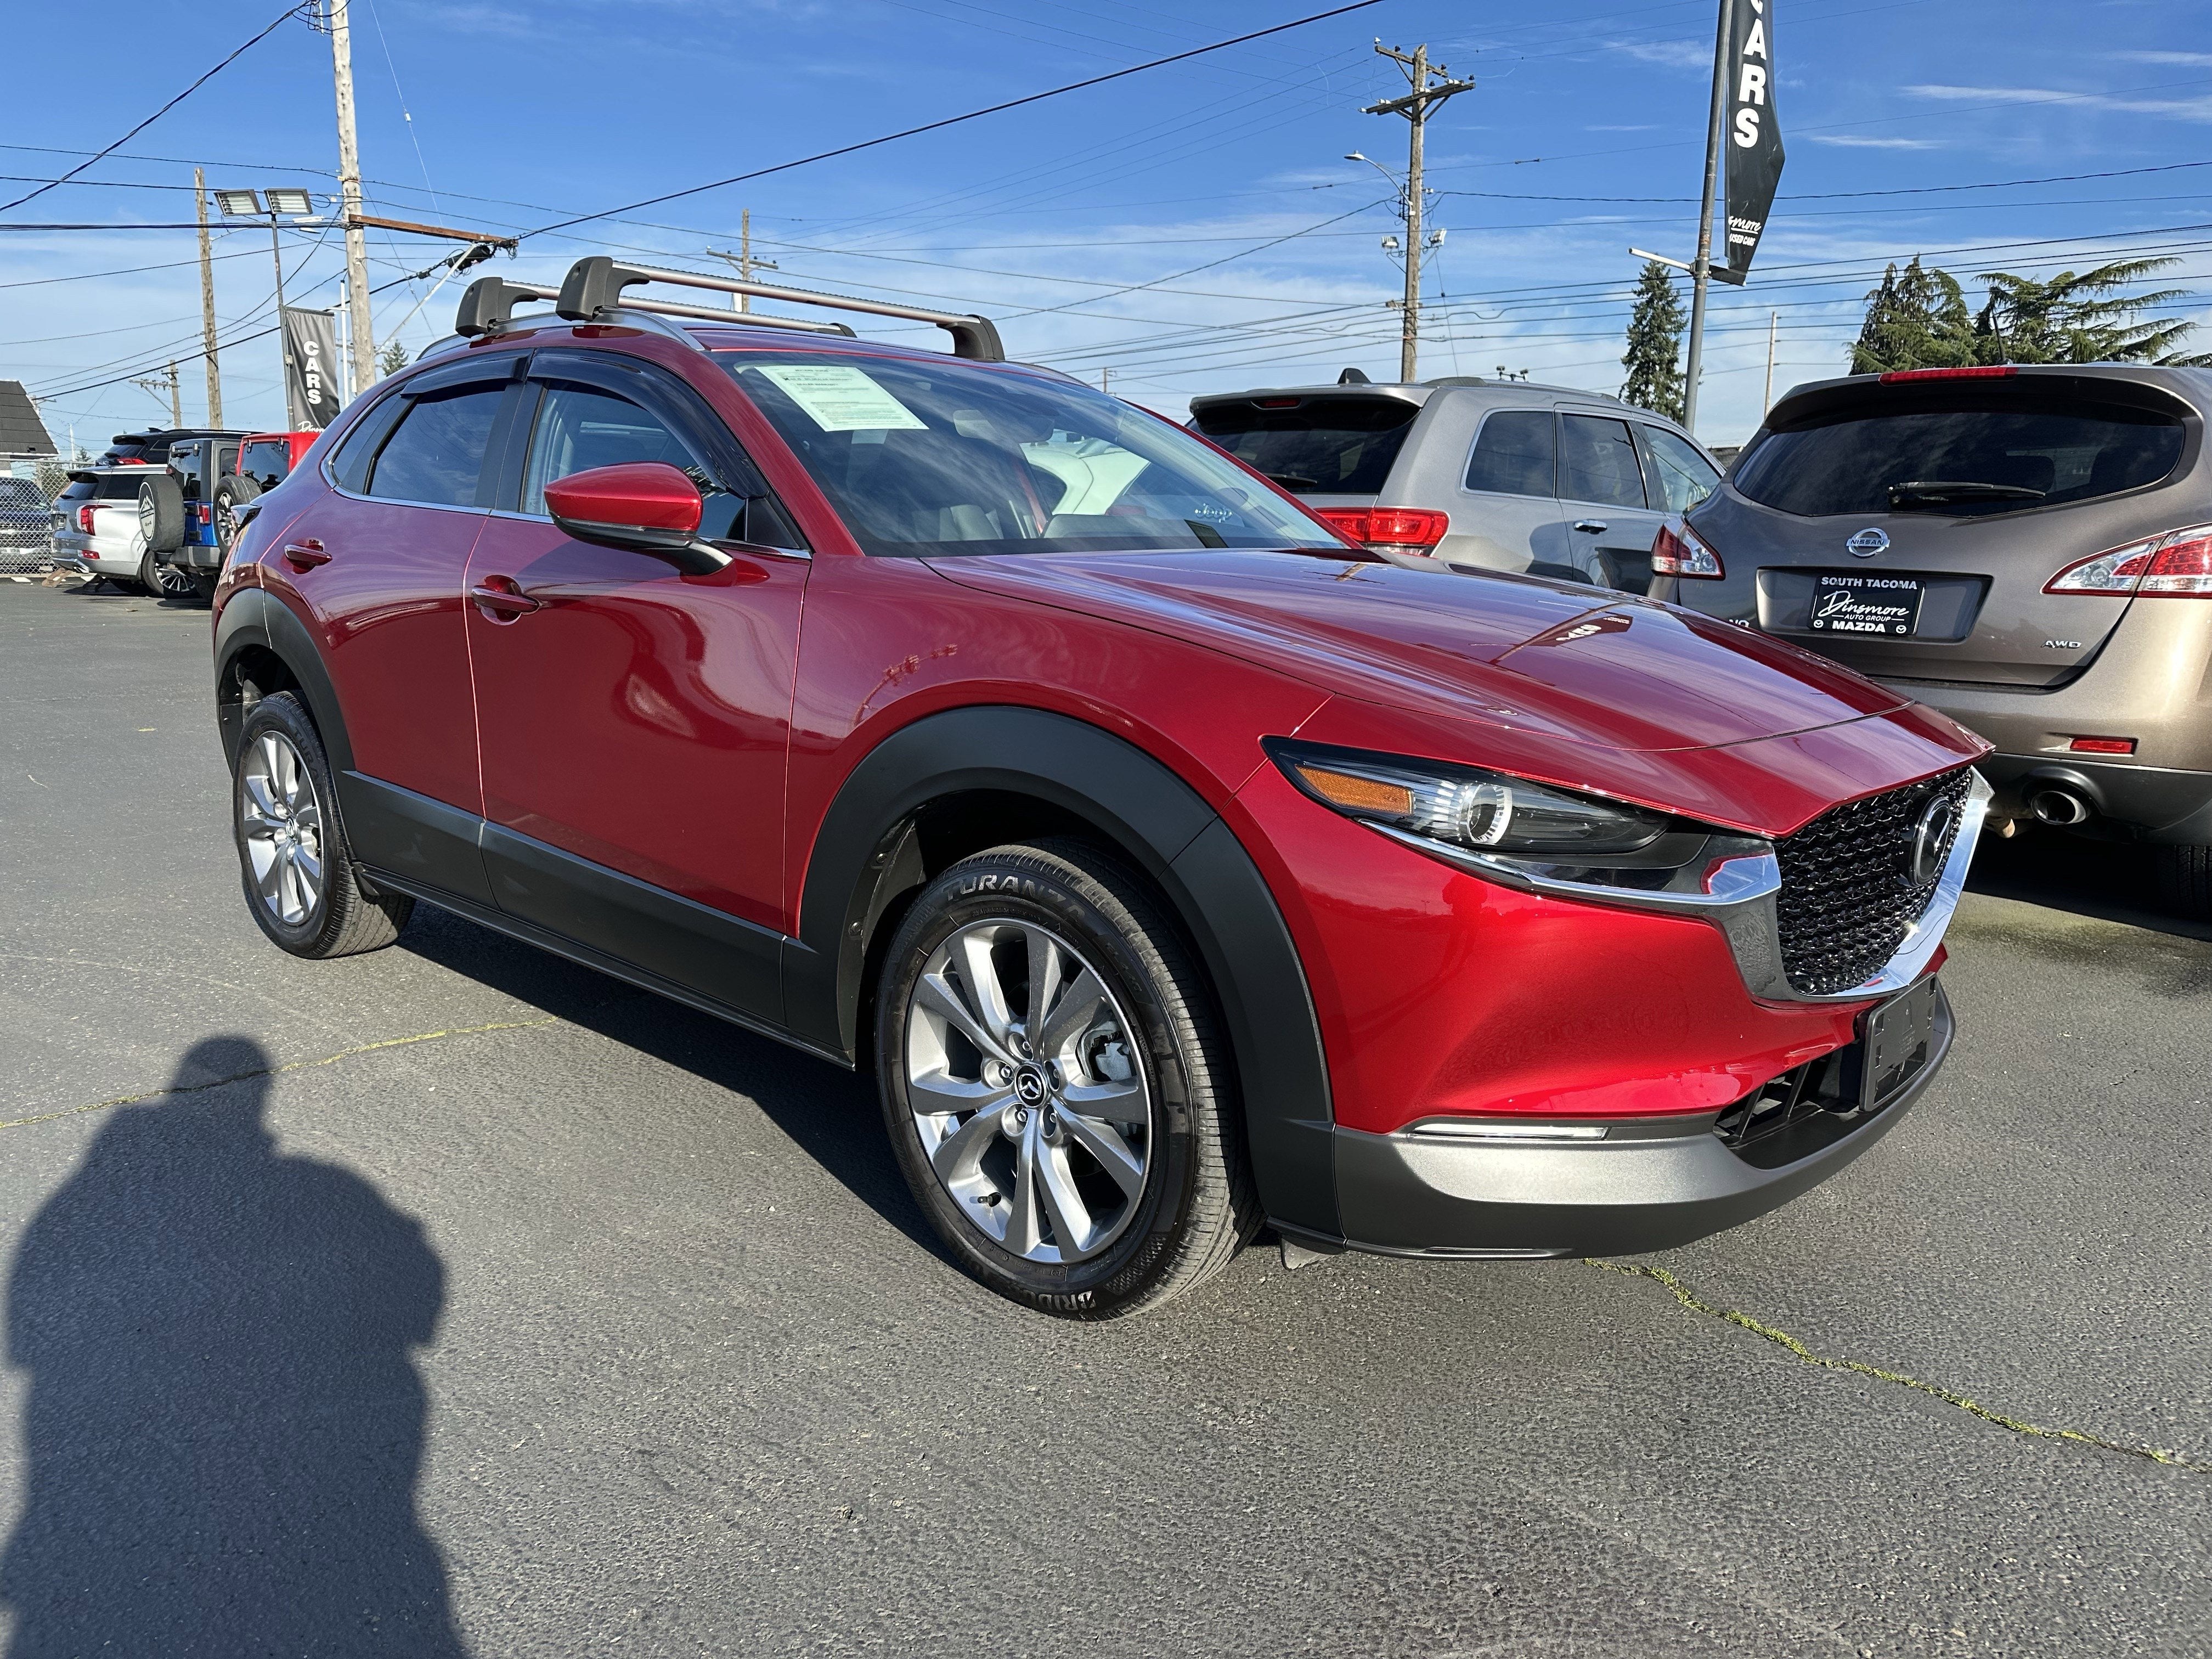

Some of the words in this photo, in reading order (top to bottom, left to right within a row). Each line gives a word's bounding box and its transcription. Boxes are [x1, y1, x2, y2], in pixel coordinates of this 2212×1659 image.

[303, 341, 322, 404] CARS
[1821, 577, 1863, 587] SOUTH
[1866, 579, 1917, 590] TACOMA
[1818, 590, 1910, 617] Dinsmore
[1832, 620, 1886, 633] MAZDA
[2040, 640, 2082, 648] AWD
